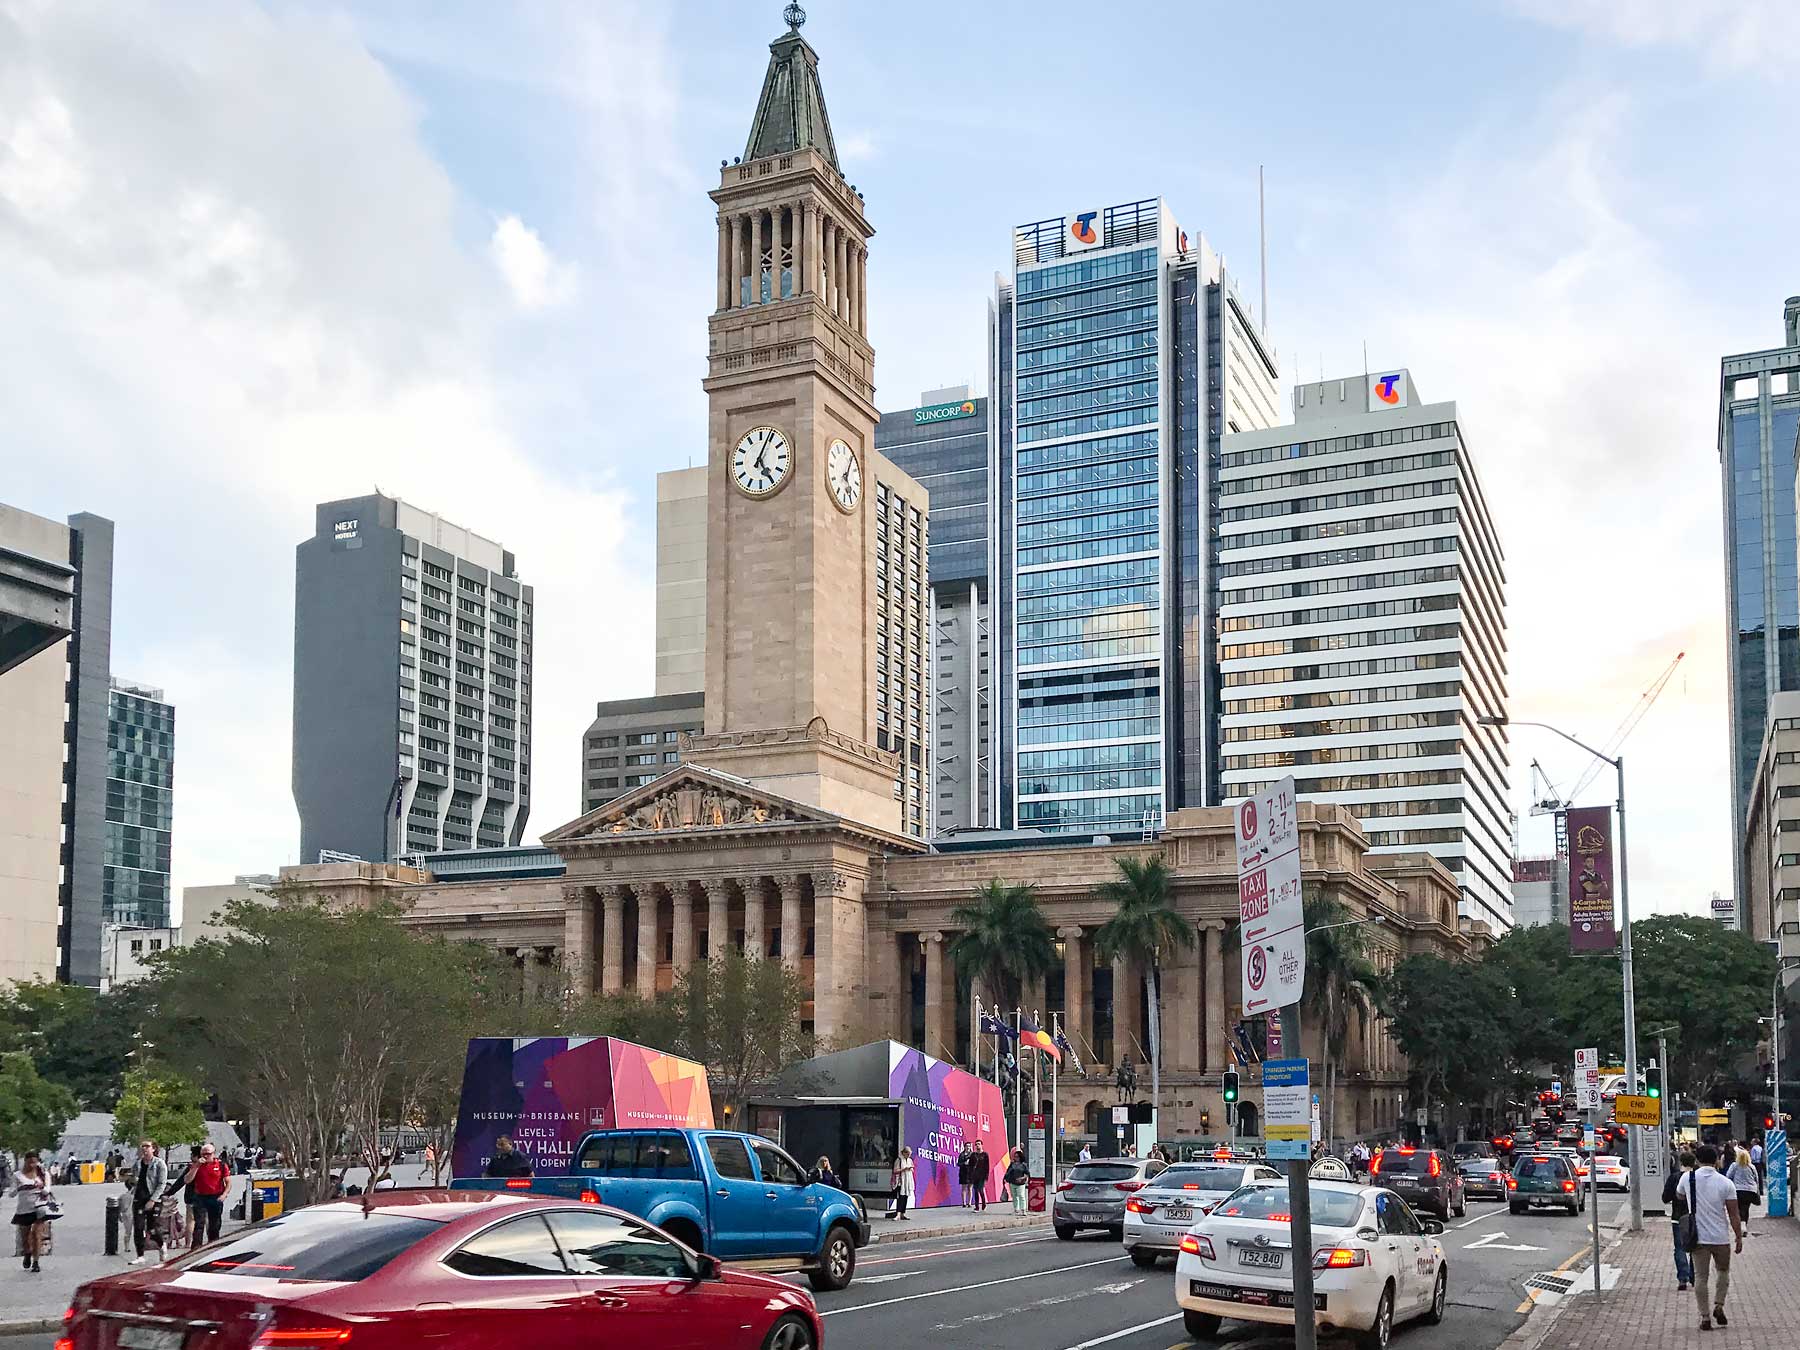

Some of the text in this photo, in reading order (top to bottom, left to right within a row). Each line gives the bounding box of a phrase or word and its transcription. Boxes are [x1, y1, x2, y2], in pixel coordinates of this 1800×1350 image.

[915, 406, 961, 422] SUNCORP
[335, 519, 358, 532] NEXT
[335, 531, 356, 540] HOTELS
[1241, 871, 1265, 897] TAXI
[1242, 894, 1268, 921] ZONE
[1282, 950, 1295, 961] ALL
[1278, 960, 1299, 976] OTHER
[1279, 973, 1297, 985] TIMES
[908, 1096, 937, 1111] MUSEUM
[946, 1107, 976, 1123] BRISBANE
[1630, 1101, 1646, 1109] END
[473, 1112, 513, 1120] MUSEUM
[530, 1112, 580, 1120] BRISBANE
[627, 1111, 654, 1119] MUSEUM
[1617, 1110, 1658, 1121] ROADWORK
[519, 1128, 546, 1137] LEVEL
[940, 1122, 963, 1137] LEVEL 3
[928, 1131, 951, 1150] CITY
[537, 1141, 574, 1154] HALL
[540, 1158, 566, 1167] OPEN
[917, 1147, 953, 1165] FREE ENTRY
[1194, 1284, 1232, 1297] SIRROMET
